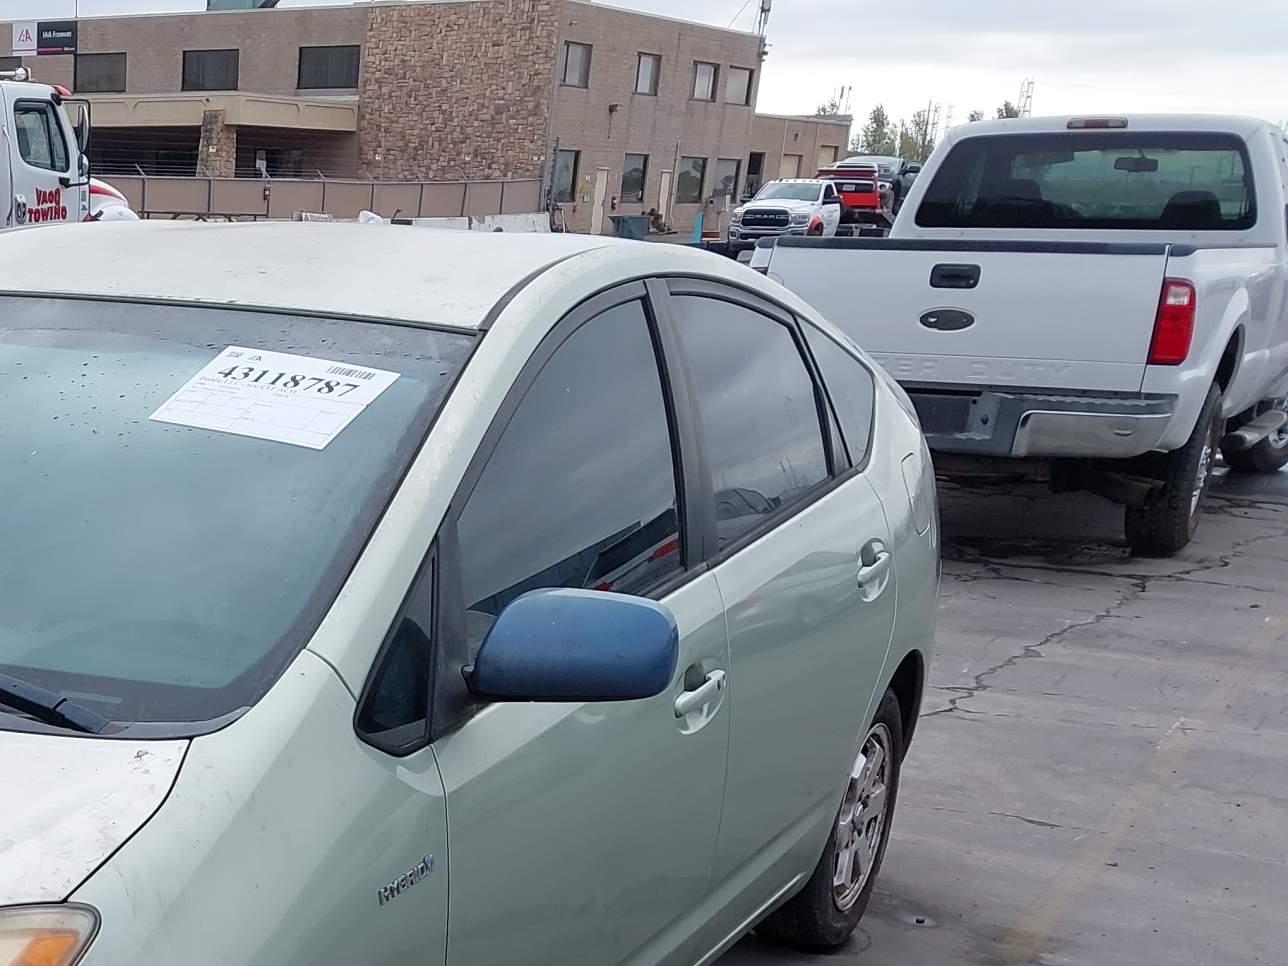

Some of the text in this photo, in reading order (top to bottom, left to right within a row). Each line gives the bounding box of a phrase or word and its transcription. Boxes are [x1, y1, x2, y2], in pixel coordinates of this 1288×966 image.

[217, 365, 360, 397] 43118787
[968, 360, 1072, 382] DUTY
[377, 862, 428, 906] HYBRID
